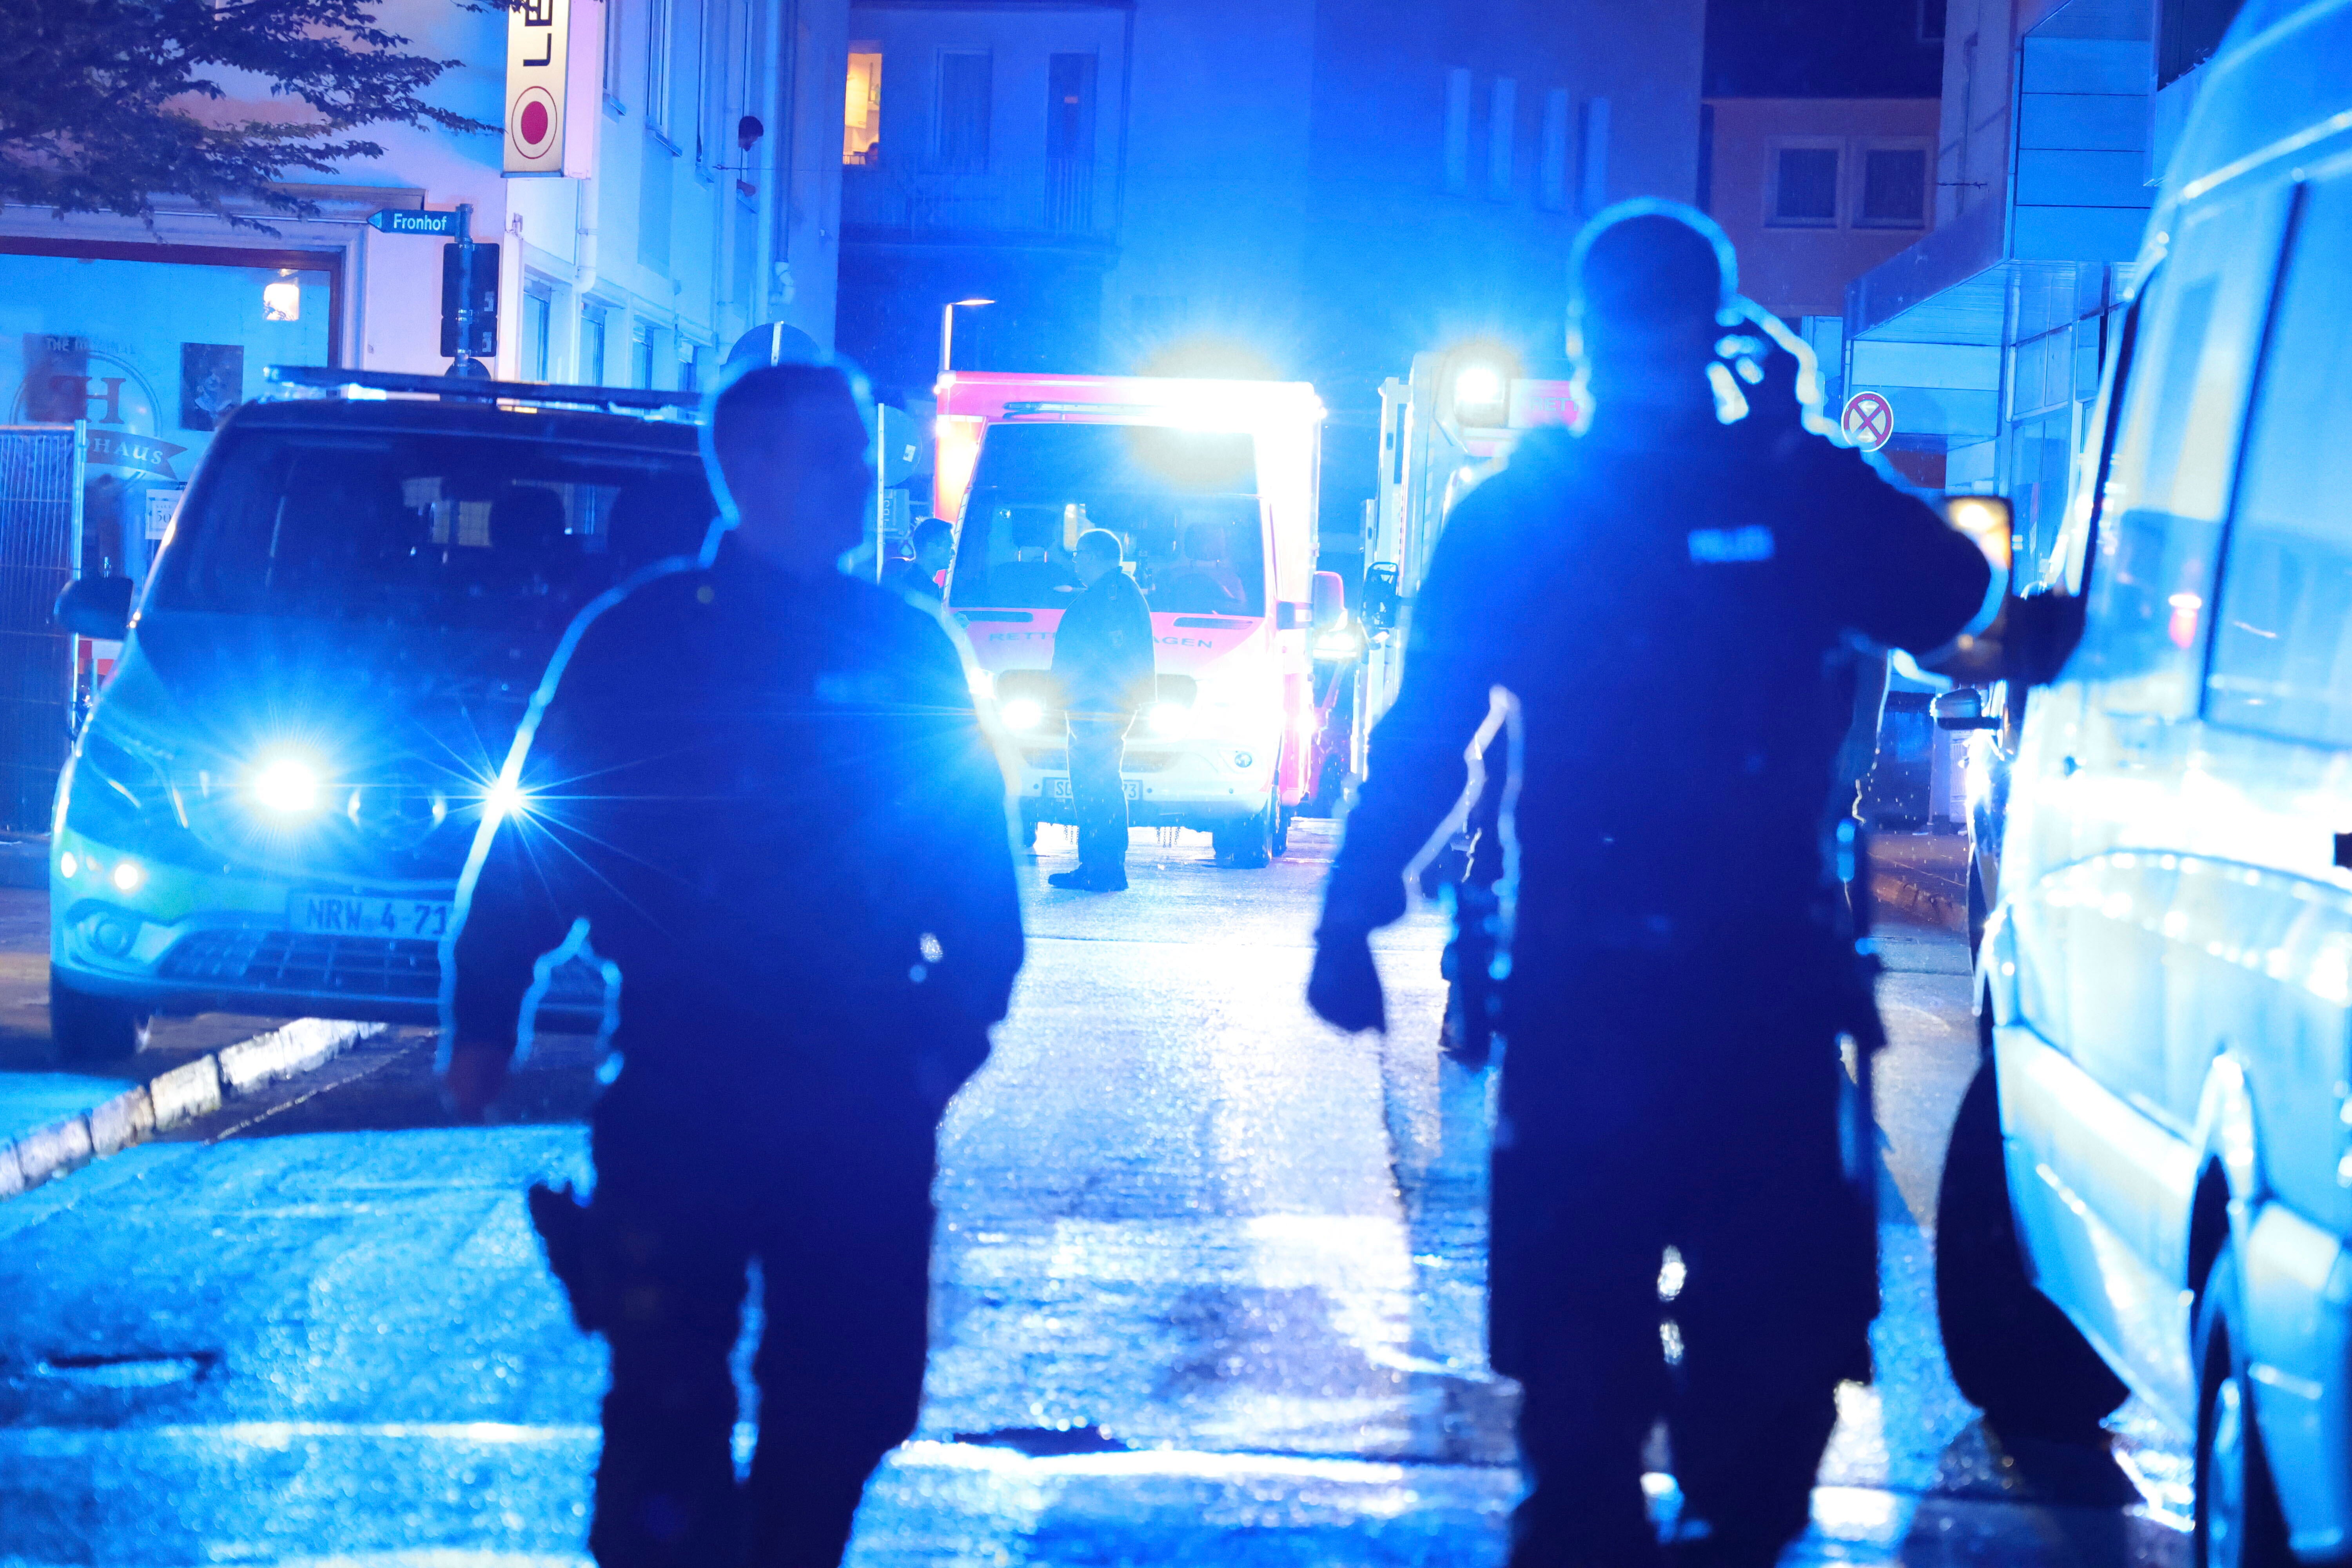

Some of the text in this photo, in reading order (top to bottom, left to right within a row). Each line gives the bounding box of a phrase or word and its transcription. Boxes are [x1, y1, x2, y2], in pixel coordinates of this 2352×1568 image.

[394, 213, 447, 230] Fronhof
[1530, 396, 1578, 412] RETT
[87, 438, 163, 464] HAUS
[307, 898, 447, 935] NRW 4-71
